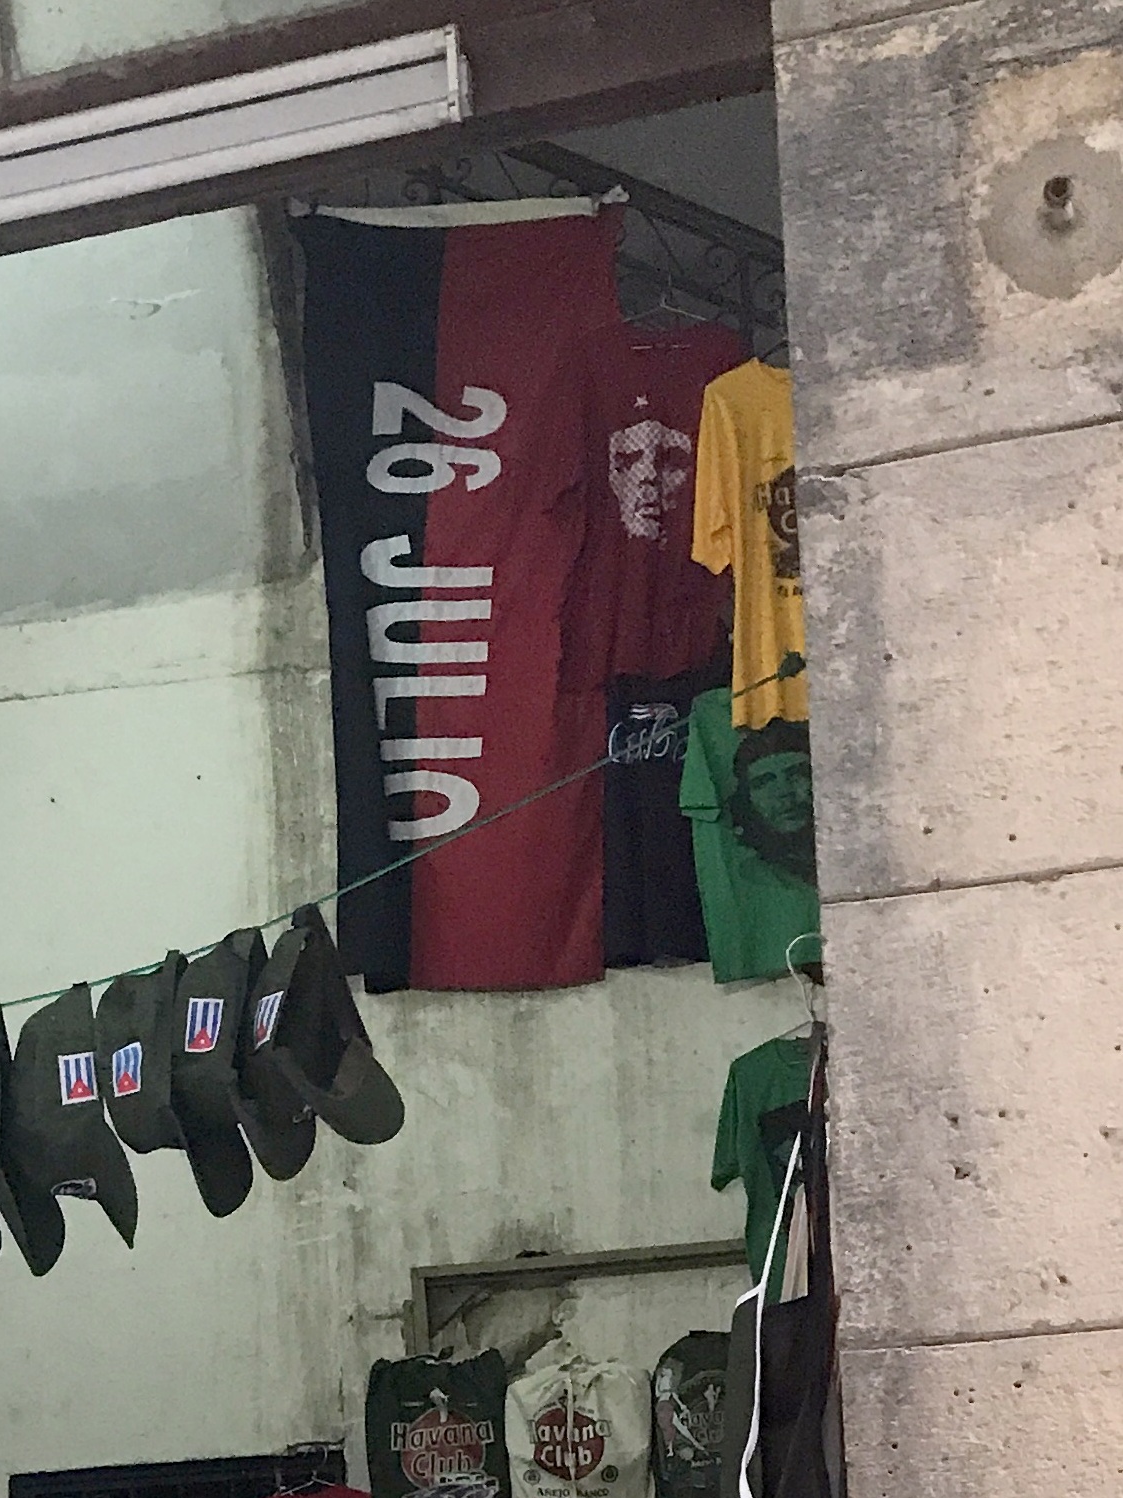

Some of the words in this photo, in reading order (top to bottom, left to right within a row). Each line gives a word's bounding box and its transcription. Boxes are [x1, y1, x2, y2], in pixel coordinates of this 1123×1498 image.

[365, 381, 508, 494] 26
[360, 533, 493, 842] JULIO
[390, 1420, 496, 1451] Havana
[411, 1450, 472, 1479] Club
[540, 1445, 594, 1468] Club
